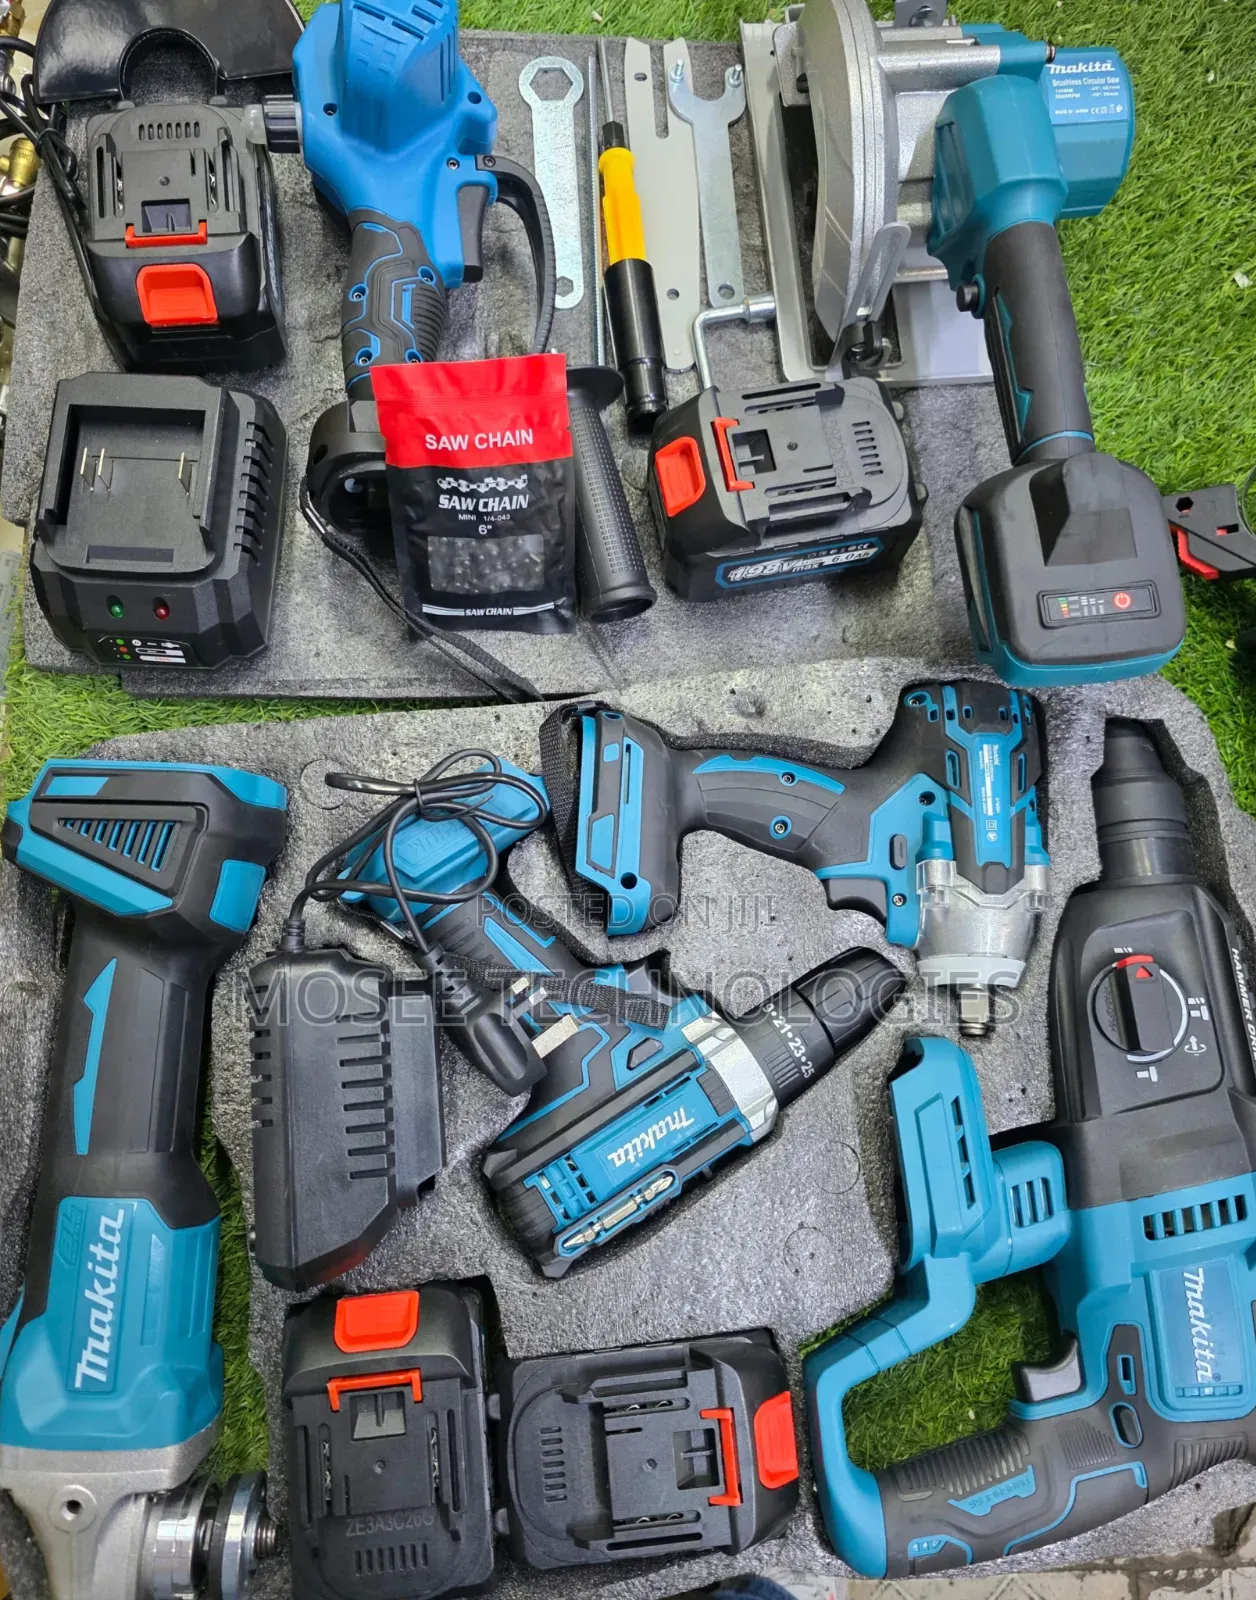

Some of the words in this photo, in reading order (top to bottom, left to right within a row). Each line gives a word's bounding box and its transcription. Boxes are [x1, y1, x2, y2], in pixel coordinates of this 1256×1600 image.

[1052, 78, 1082, 87] Brushless
[1082, 77, 1106, 85] Circular
[1106, 76, 1120, 84] Saw
[425, 433, 469, 451] SAW
[474, 428, 534, 450] CHAIN
[438, 494, 477, 512] SAW
[478, 494, 530, 513] CHAIN
[458, 513, 477, 522] MINI
[831, 551, 871, 563] 6.0Ah
[792, 563, 820, 573] max
[465, 608, 486, 617] SAW
[486, 607, 513, 617] CHAIN
[1231, 947, 1253, 1021] HAMMER
